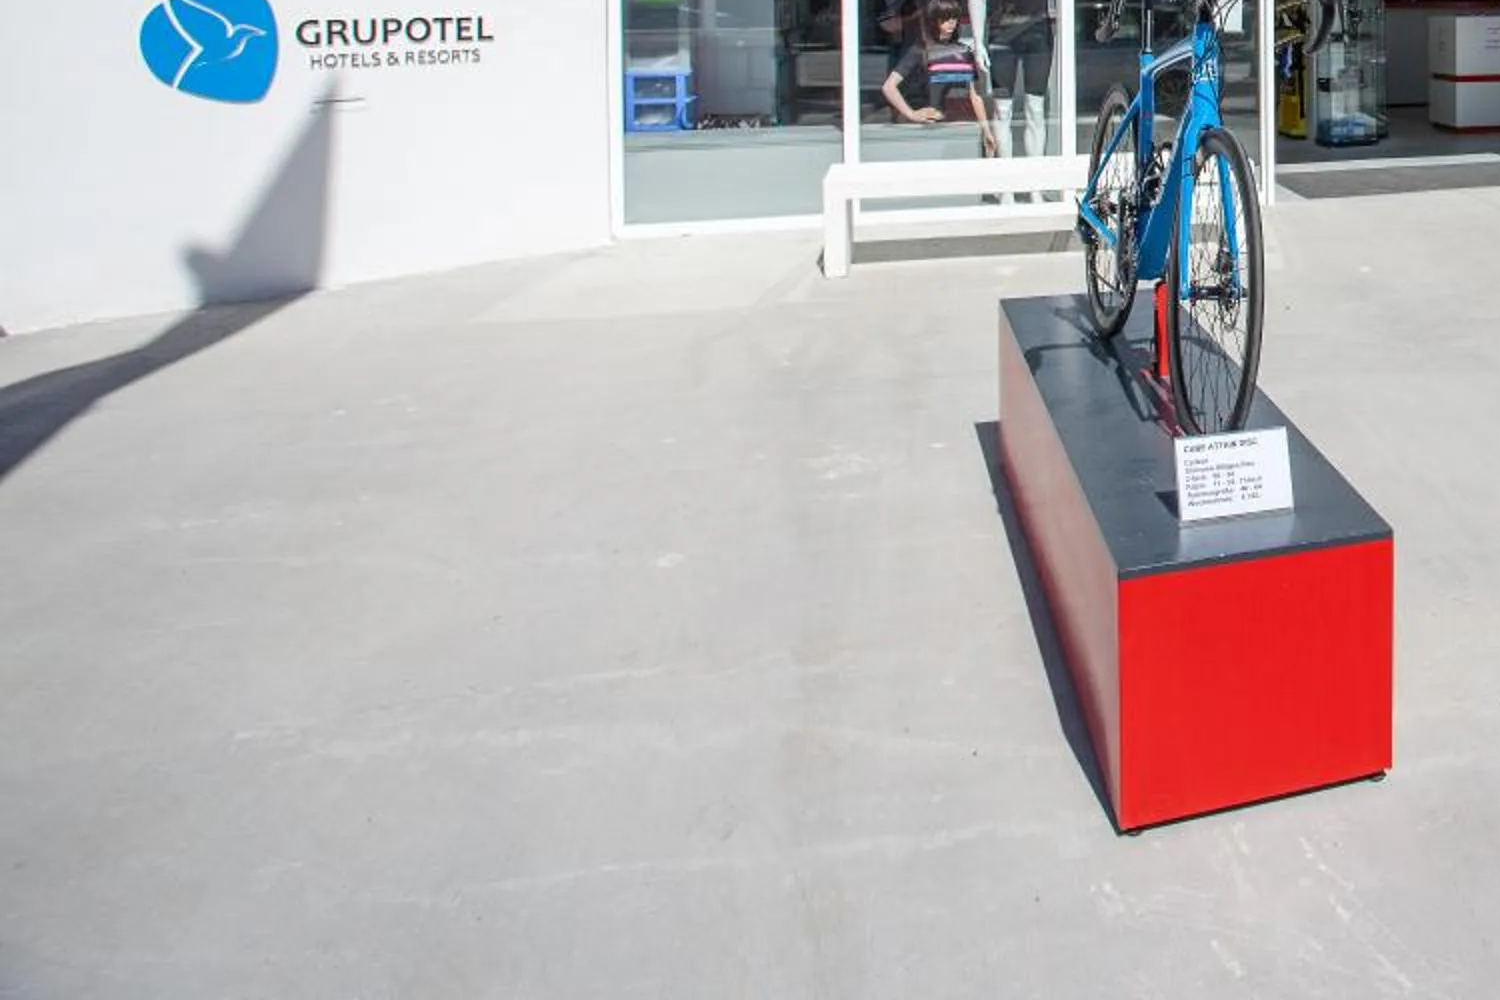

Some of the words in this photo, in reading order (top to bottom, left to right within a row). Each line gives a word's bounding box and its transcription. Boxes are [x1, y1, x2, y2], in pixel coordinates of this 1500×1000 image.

[295, 16, 494, 46] GRUPOTEL
[310, 49, 381, 68] HOTELS
[385, 50, 400, 67] &
[404, 48, 481, 65] RESORTS
